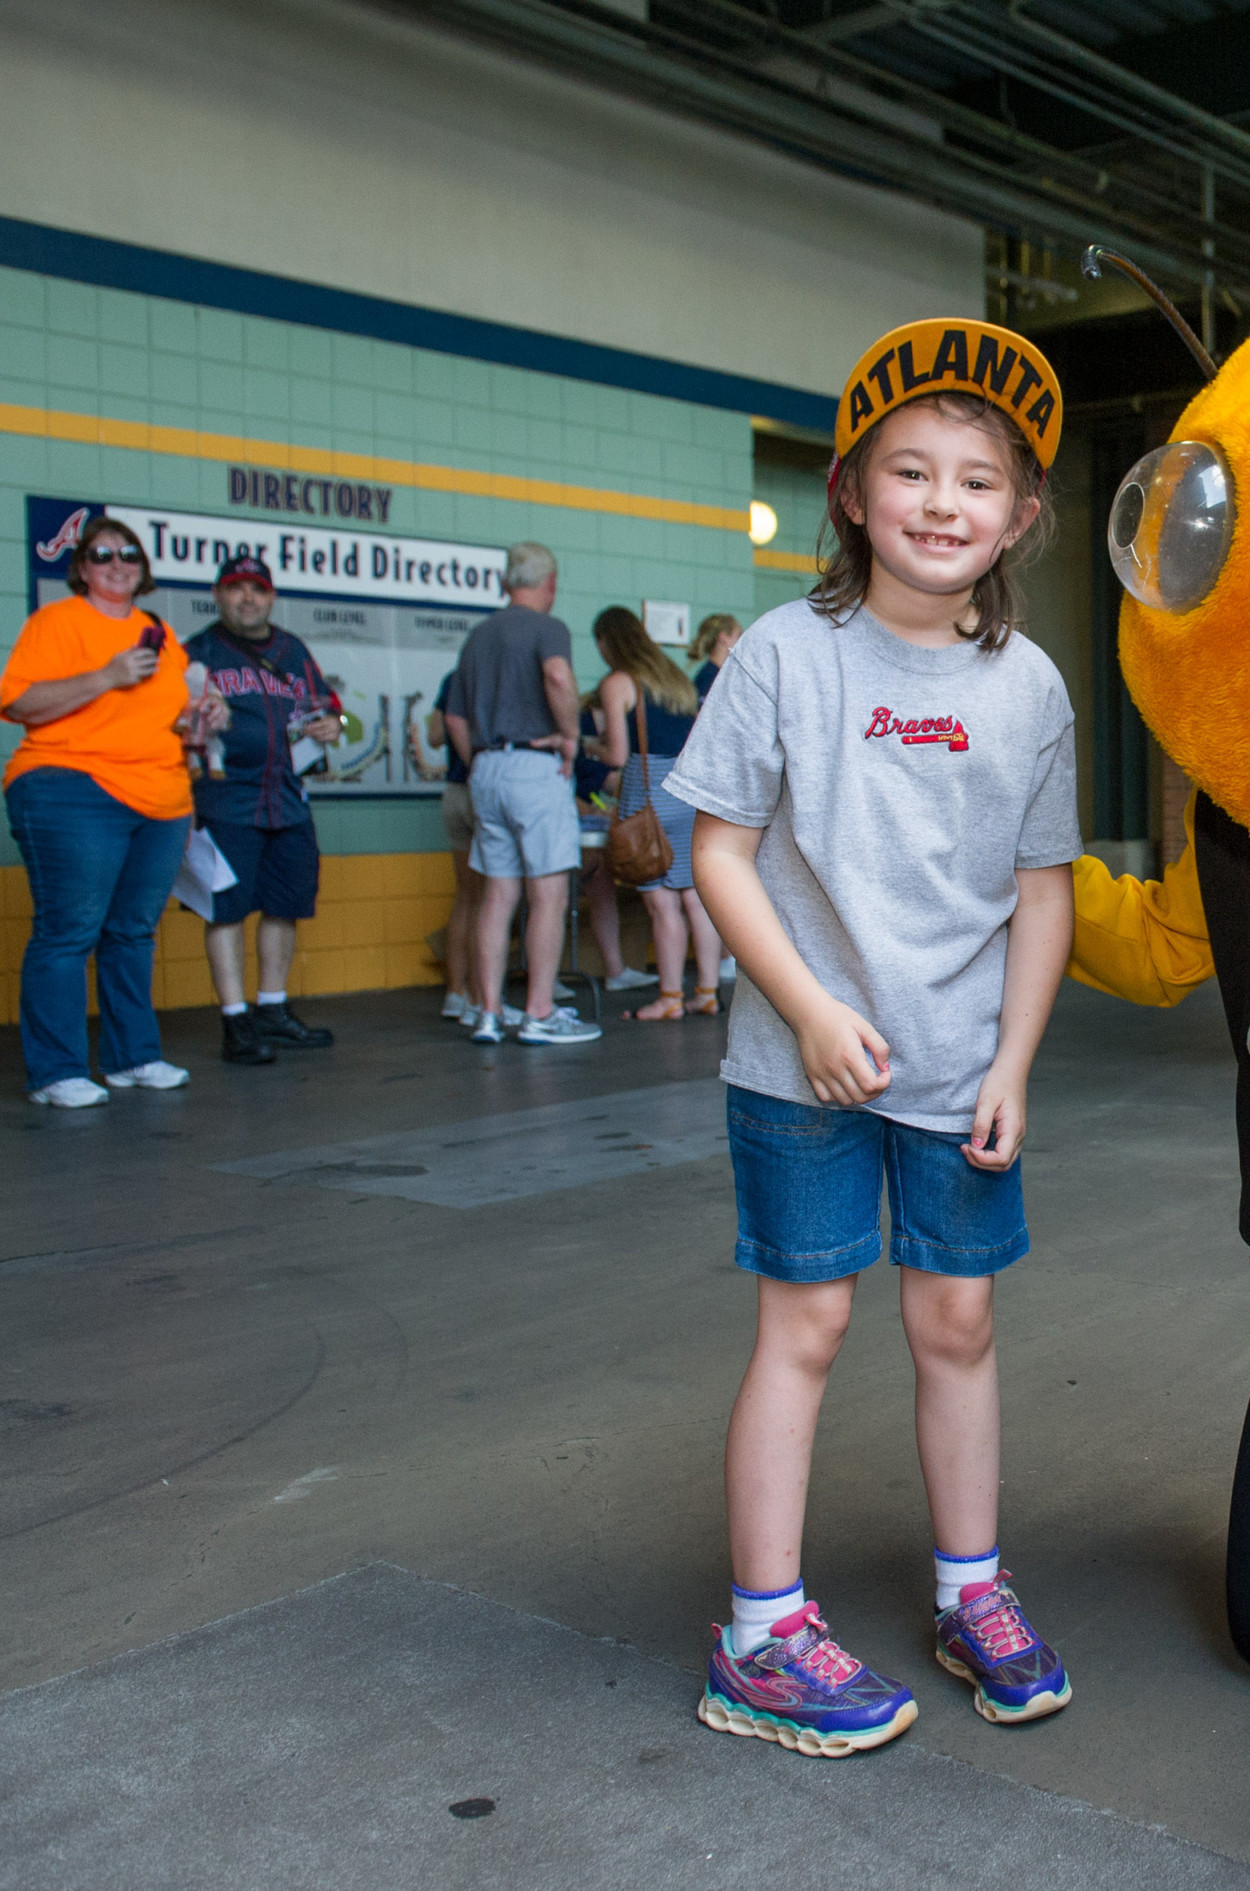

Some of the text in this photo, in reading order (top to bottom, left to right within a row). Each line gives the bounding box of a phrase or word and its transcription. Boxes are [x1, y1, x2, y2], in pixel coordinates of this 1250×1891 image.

[849, 329, 1056, 438] ATLANTA
[228, 466, 393, 524] DIRECTORY
[148, 520, 505, 600] Turner Field Directory
[864, 706, 953, 740] Braves
